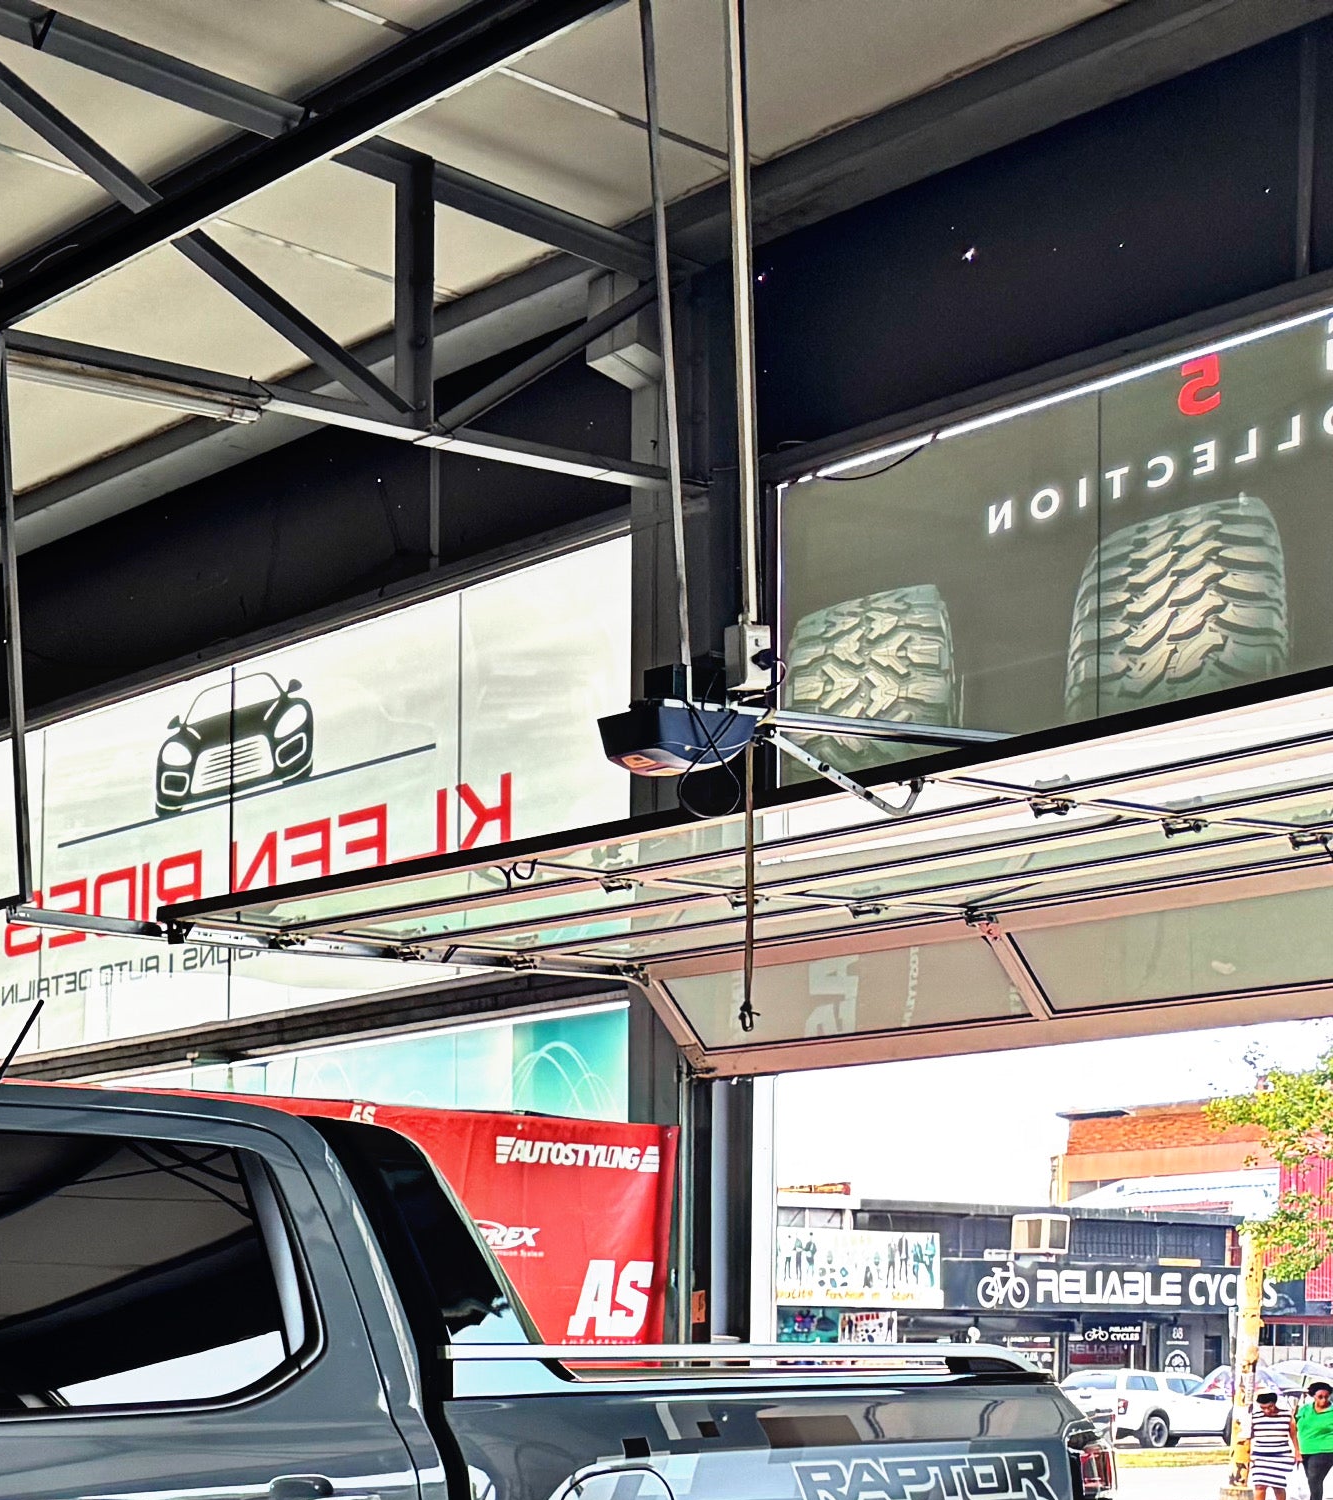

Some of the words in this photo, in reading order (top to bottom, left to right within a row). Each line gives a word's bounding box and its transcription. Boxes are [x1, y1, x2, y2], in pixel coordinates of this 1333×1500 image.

[509, 1139, 641, 1171] AUTOSTYLING
[566, 1259, 654, 1337] AS
[1036, 1269, 1182, 1305] RELIABLE
[1189, 1273, 1278, 1306] CYCS
